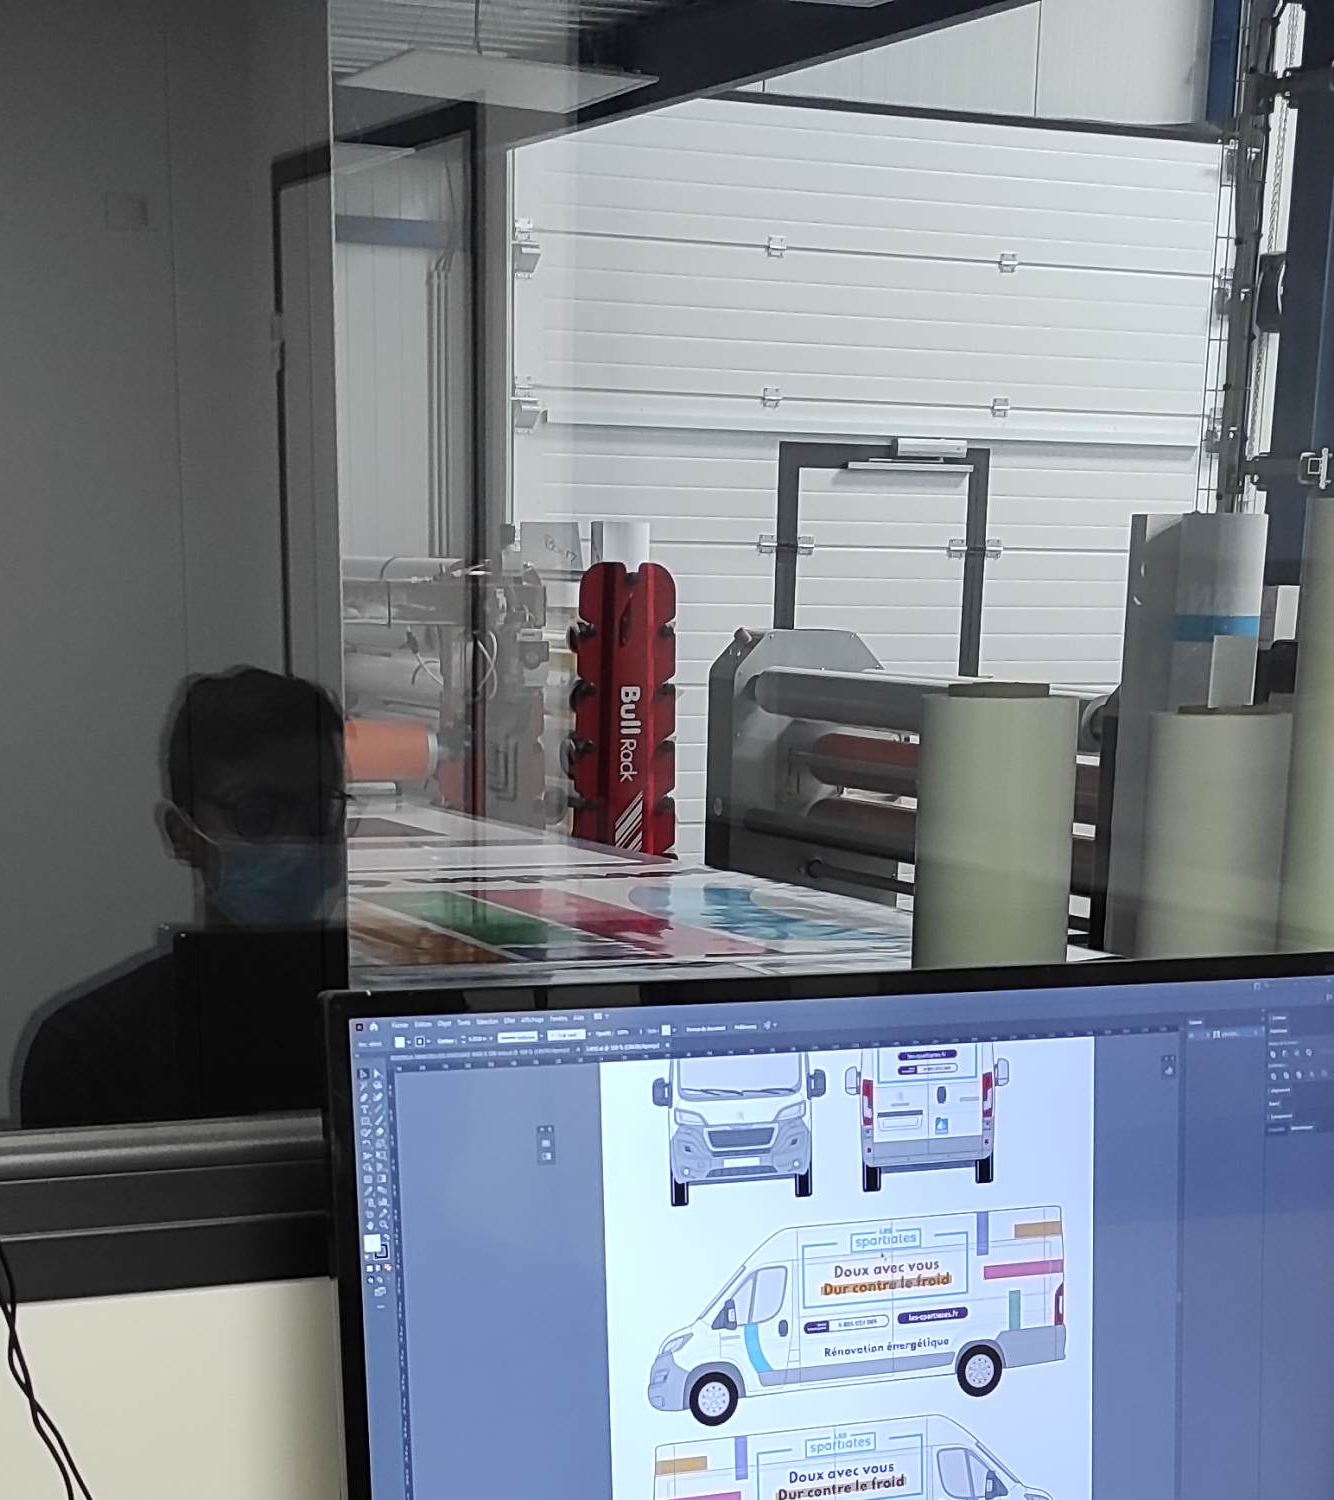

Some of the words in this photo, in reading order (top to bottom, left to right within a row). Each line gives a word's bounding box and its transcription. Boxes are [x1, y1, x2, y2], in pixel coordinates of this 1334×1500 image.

[620, 686, 641, 735] Bull
[619, 739, 638, 783] Rack
[834, 1264, 868, 1279] Doux
[873, 1263, 906, 1275] avec
[908, 1260, 940, 1272] vous
[824, 1283, 850, 1296] Dur
[852, 1279, 898, 1294] contre
[900, 1275, 914, 1290] le
[916, 1272, 952, 1289] froid
[824, 1344, 884, 1358] Rénovation
[886, 1337, 950, 1352] énergétique
[809, 1438, 872, 1453] spartiates
[789, 1471, 824, 1484] Doux
[828, 1467, 860, 1480] avec
[862, 1463, 895, 1475] vous
[807, 1483, 852, 1498] contre
[855, 1479, 868, 1491] le
[871, 1474, 906, 1490] froid
